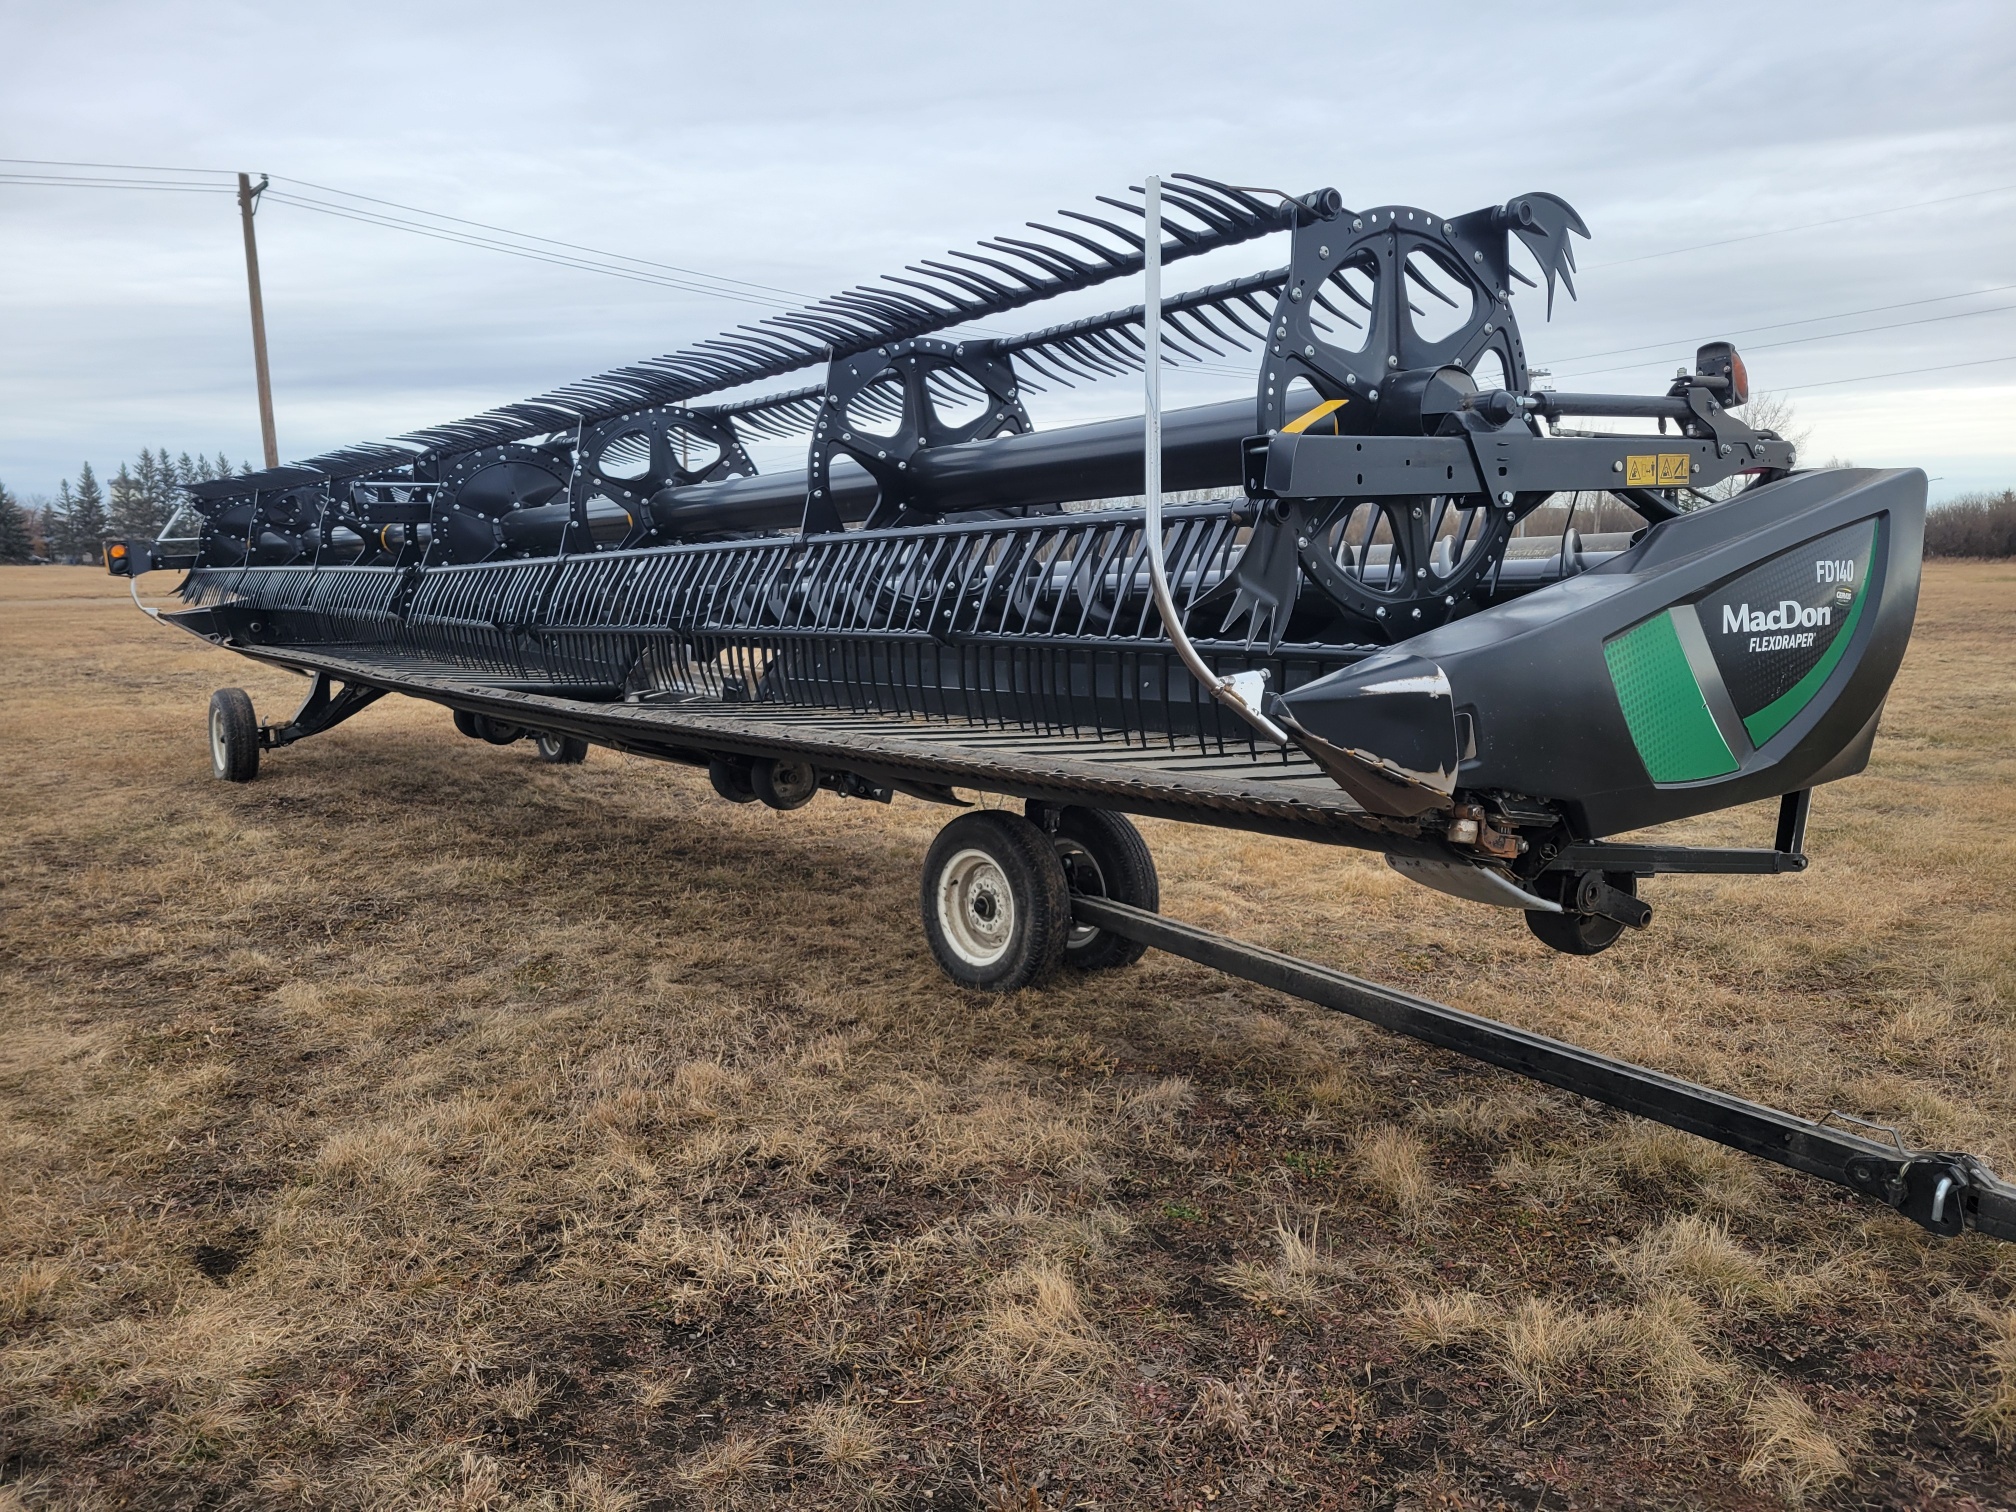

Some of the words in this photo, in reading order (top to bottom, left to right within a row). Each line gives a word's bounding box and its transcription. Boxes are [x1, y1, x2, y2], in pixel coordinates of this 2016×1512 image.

[1816, 560, 1855, 584] FD140
[1722, 601, 1832, 634] MacDon
[1749, 634, 1815, 653] FLEXDRAPER
